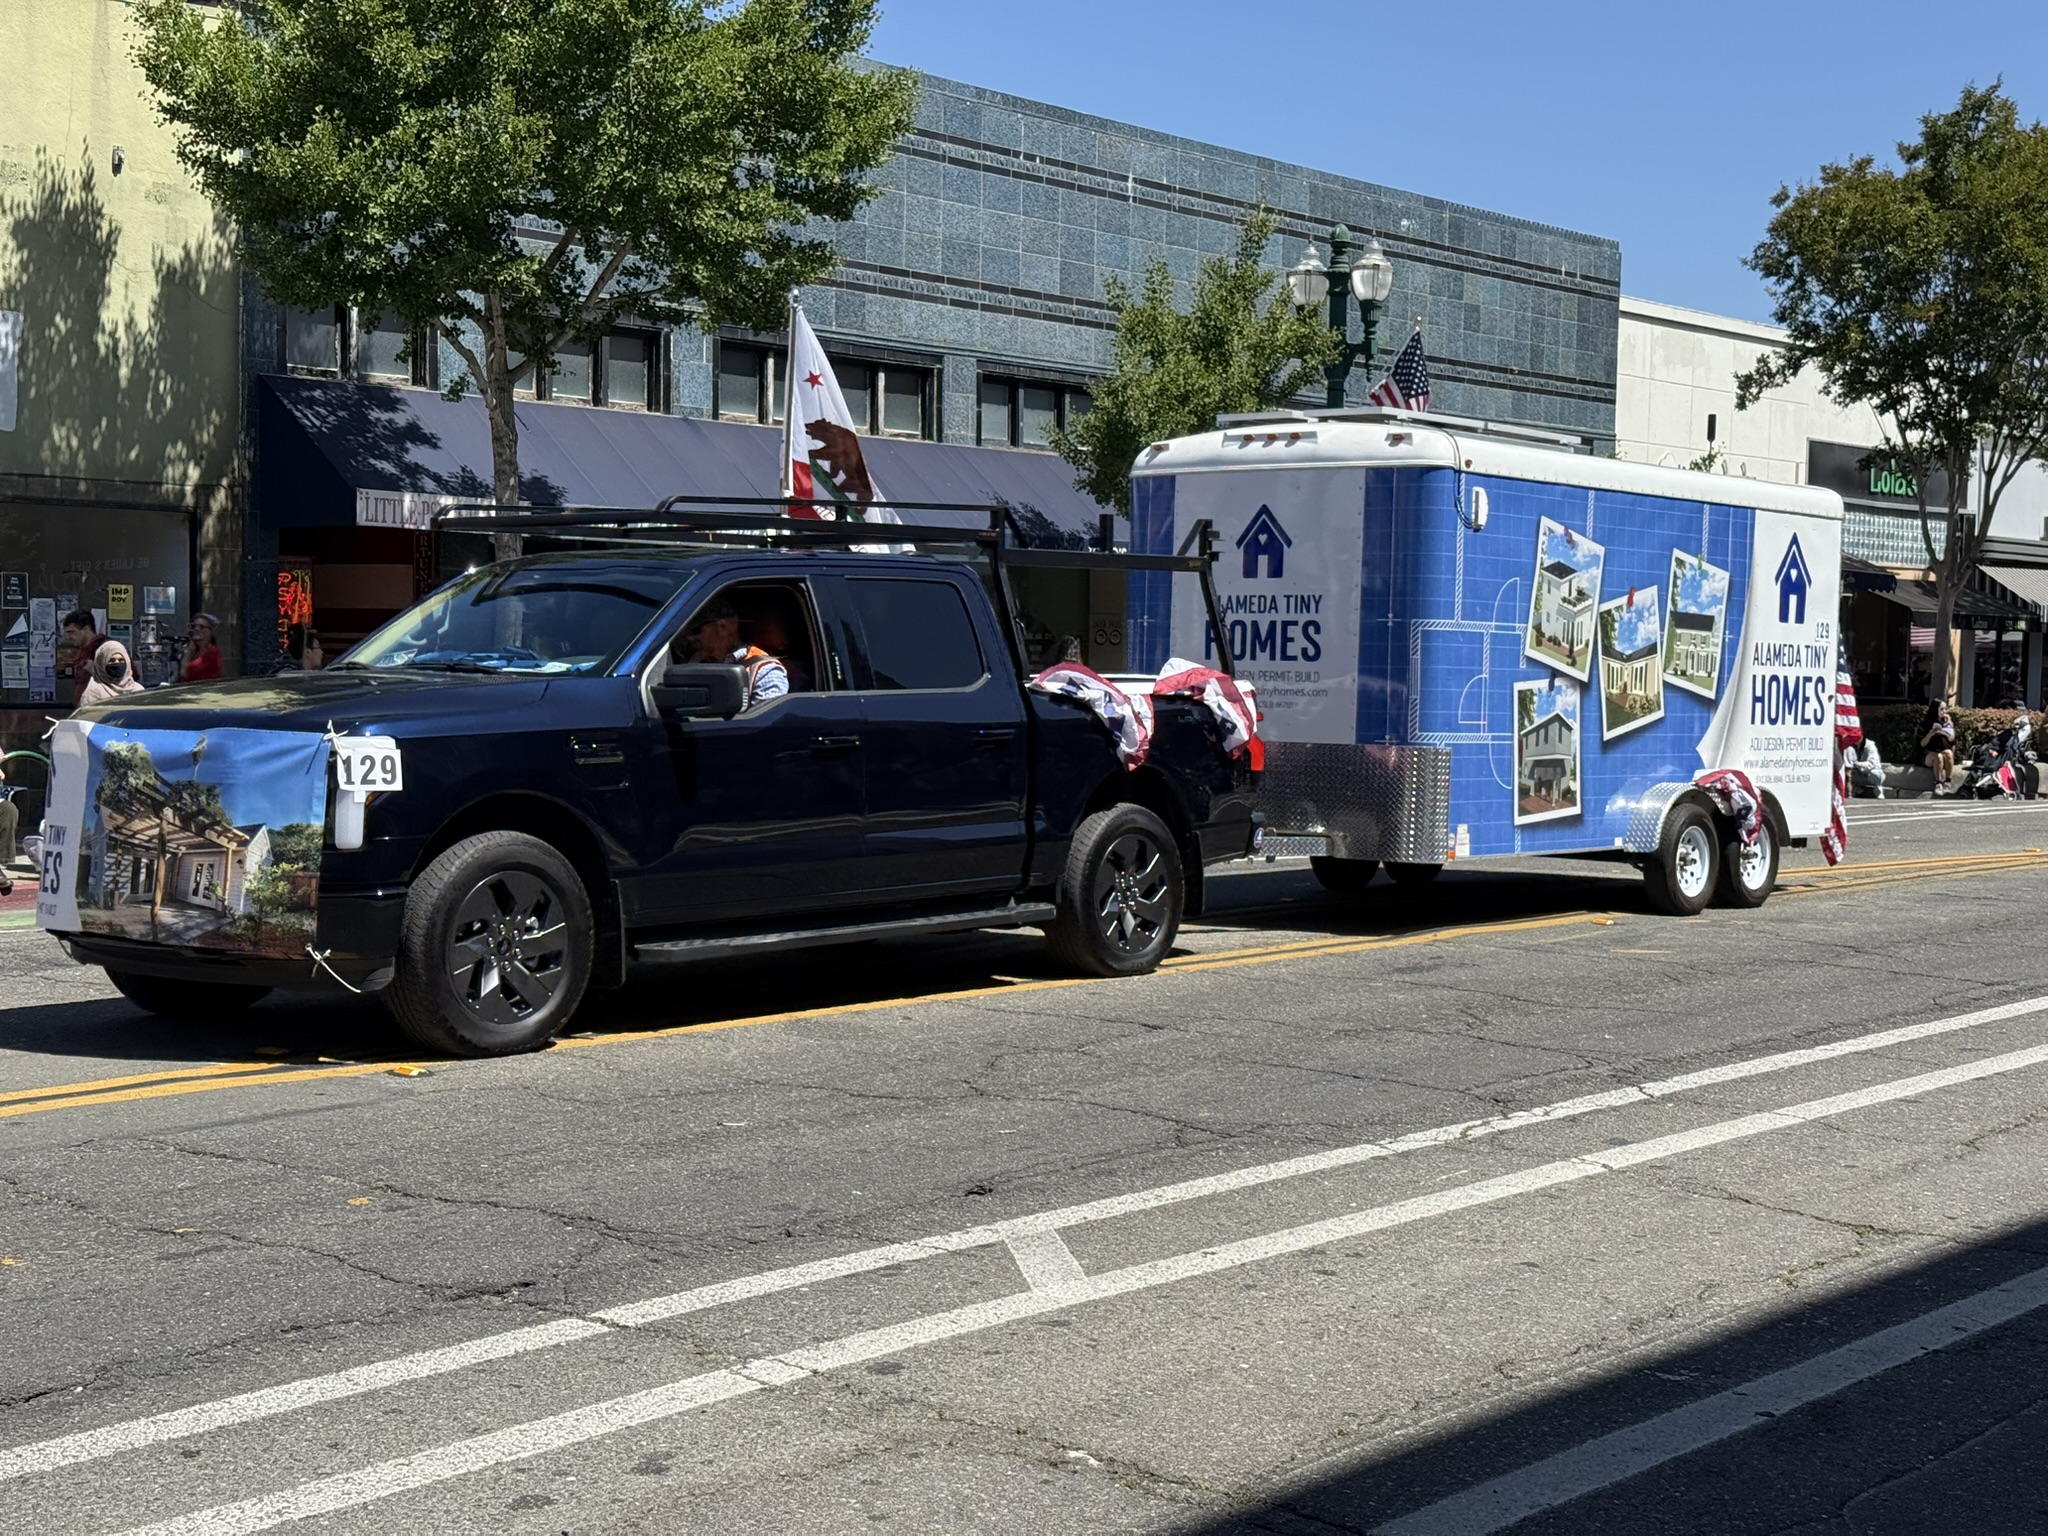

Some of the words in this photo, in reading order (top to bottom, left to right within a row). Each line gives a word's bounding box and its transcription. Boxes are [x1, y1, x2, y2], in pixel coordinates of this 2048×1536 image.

[365, 497, 417, 525] LITTLE
[112, 588, 129, 596] IMP
[1284, 594, 1323, 614] TINY
[1816, 622, 1830, 640] 129
[1752, 642, 1801, 668] ALAMEDA
[1805, 644, 1829, 669] TINY
[1751, 674, 1826, 726] HOMES
[1764, 737, 1785, 751] DESIGN
[1808, 738, 1824, 751] BUILD
[343, 755, 397, 785] 129
[48, 825, 67, 846] TINY
